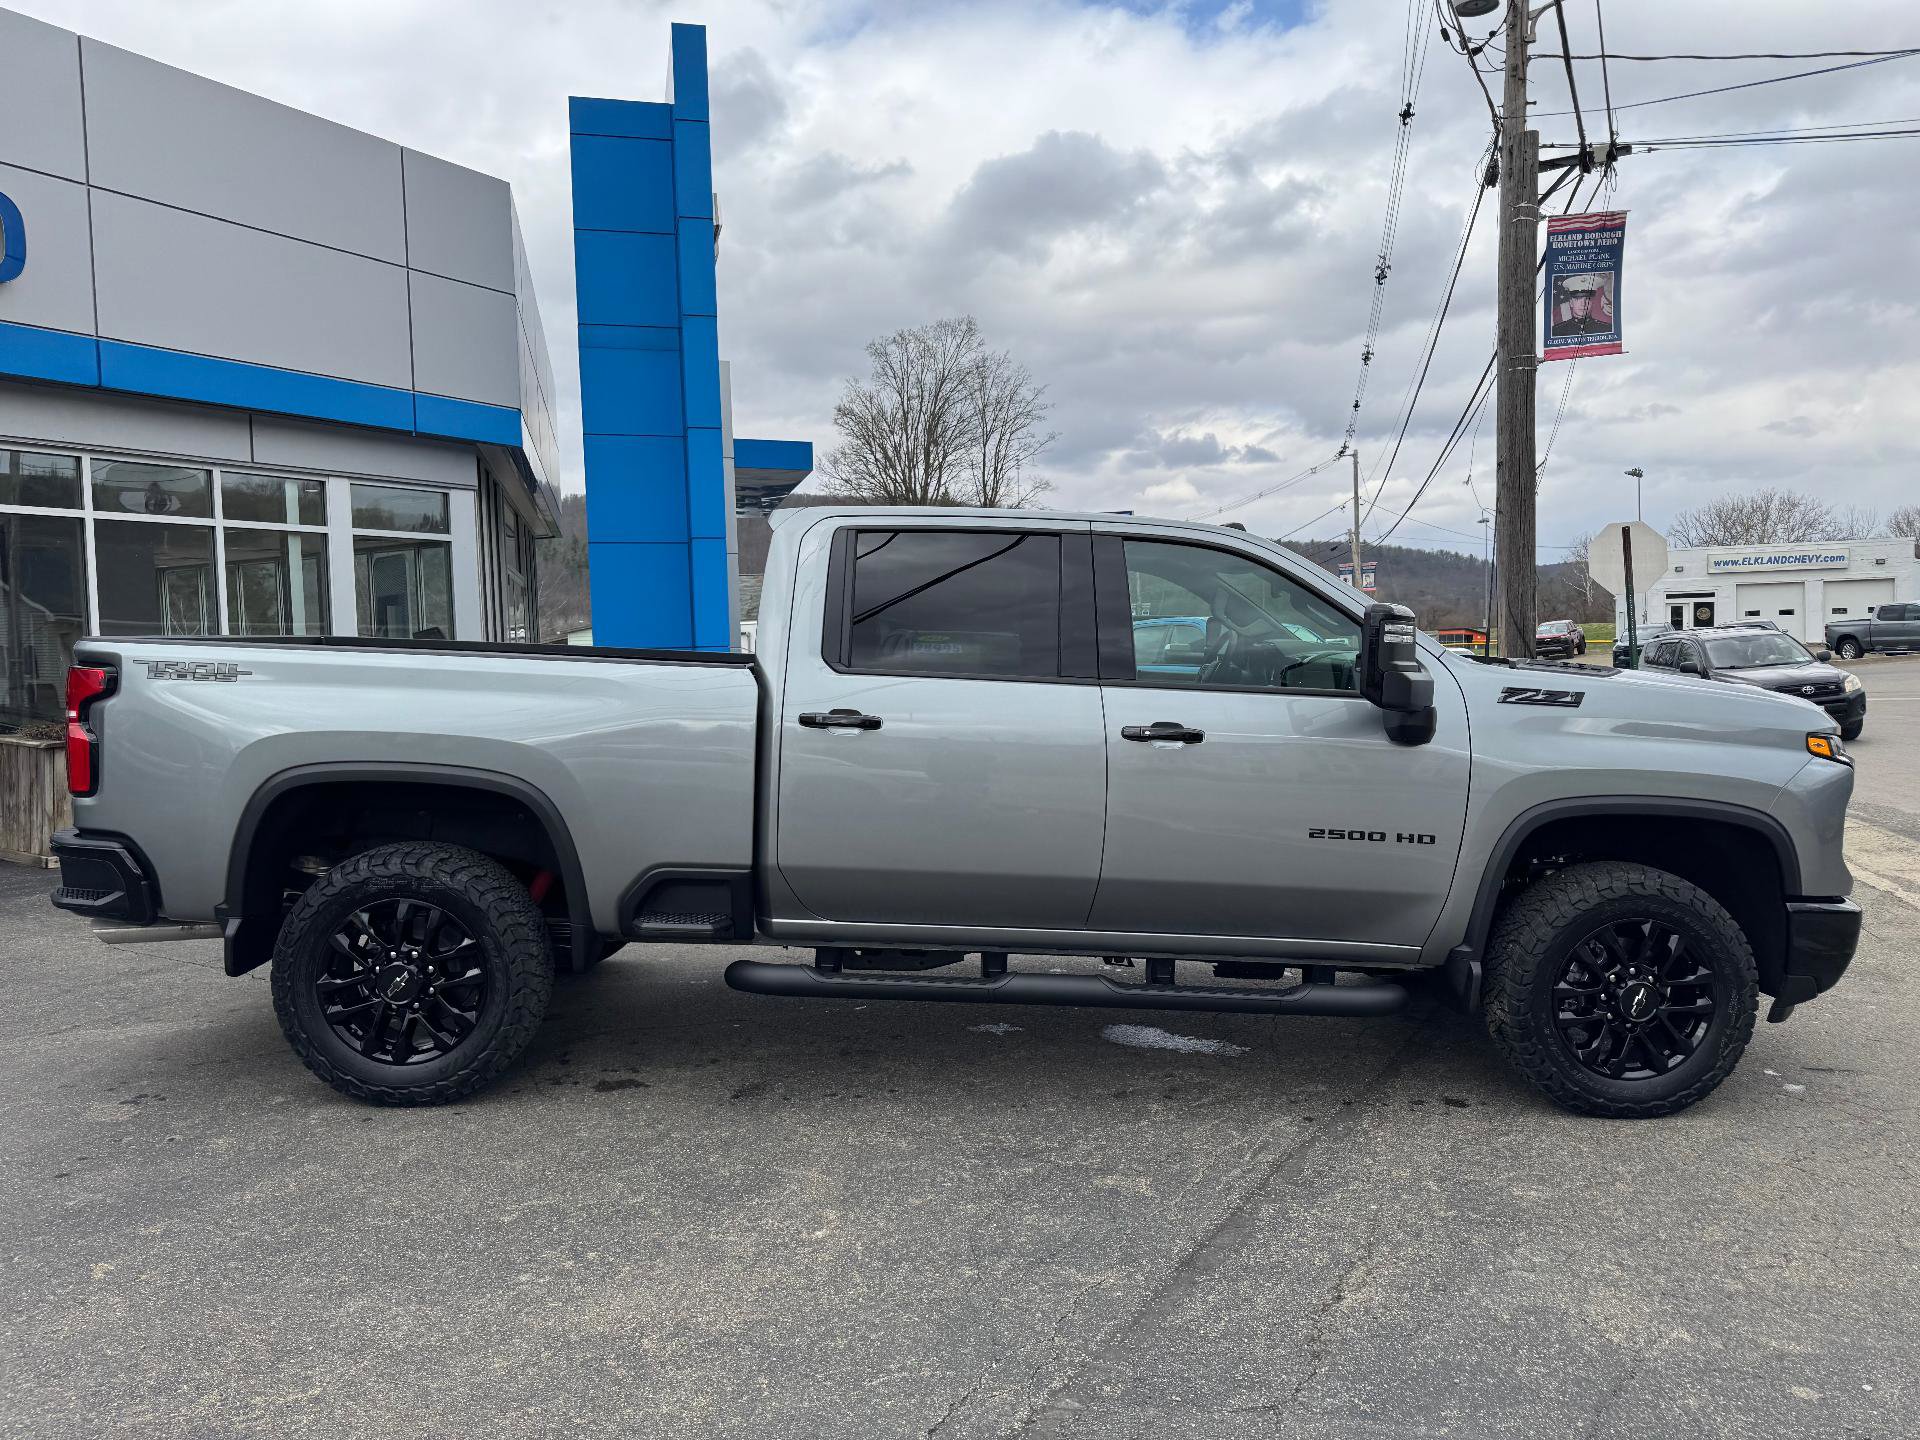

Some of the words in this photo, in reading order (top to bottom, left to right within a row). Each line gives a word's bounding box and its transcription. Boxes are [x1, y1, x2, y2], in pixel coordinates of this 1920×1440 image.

[1552, 240, 1595, 249] HOMETOWN
[1566, 262, 1592, 270] MARINE
[1713, 554, 1846, 567] www.ELKLANDCHEVY.com
[132, 660, 252, 675] TRAIL
[147, 671, 238, 682] BOSS
[1497, 686, 1586, 708] Z71
[1308, 827, 1387, 842] 2500
[1396, 832, 1436, 845] HD
